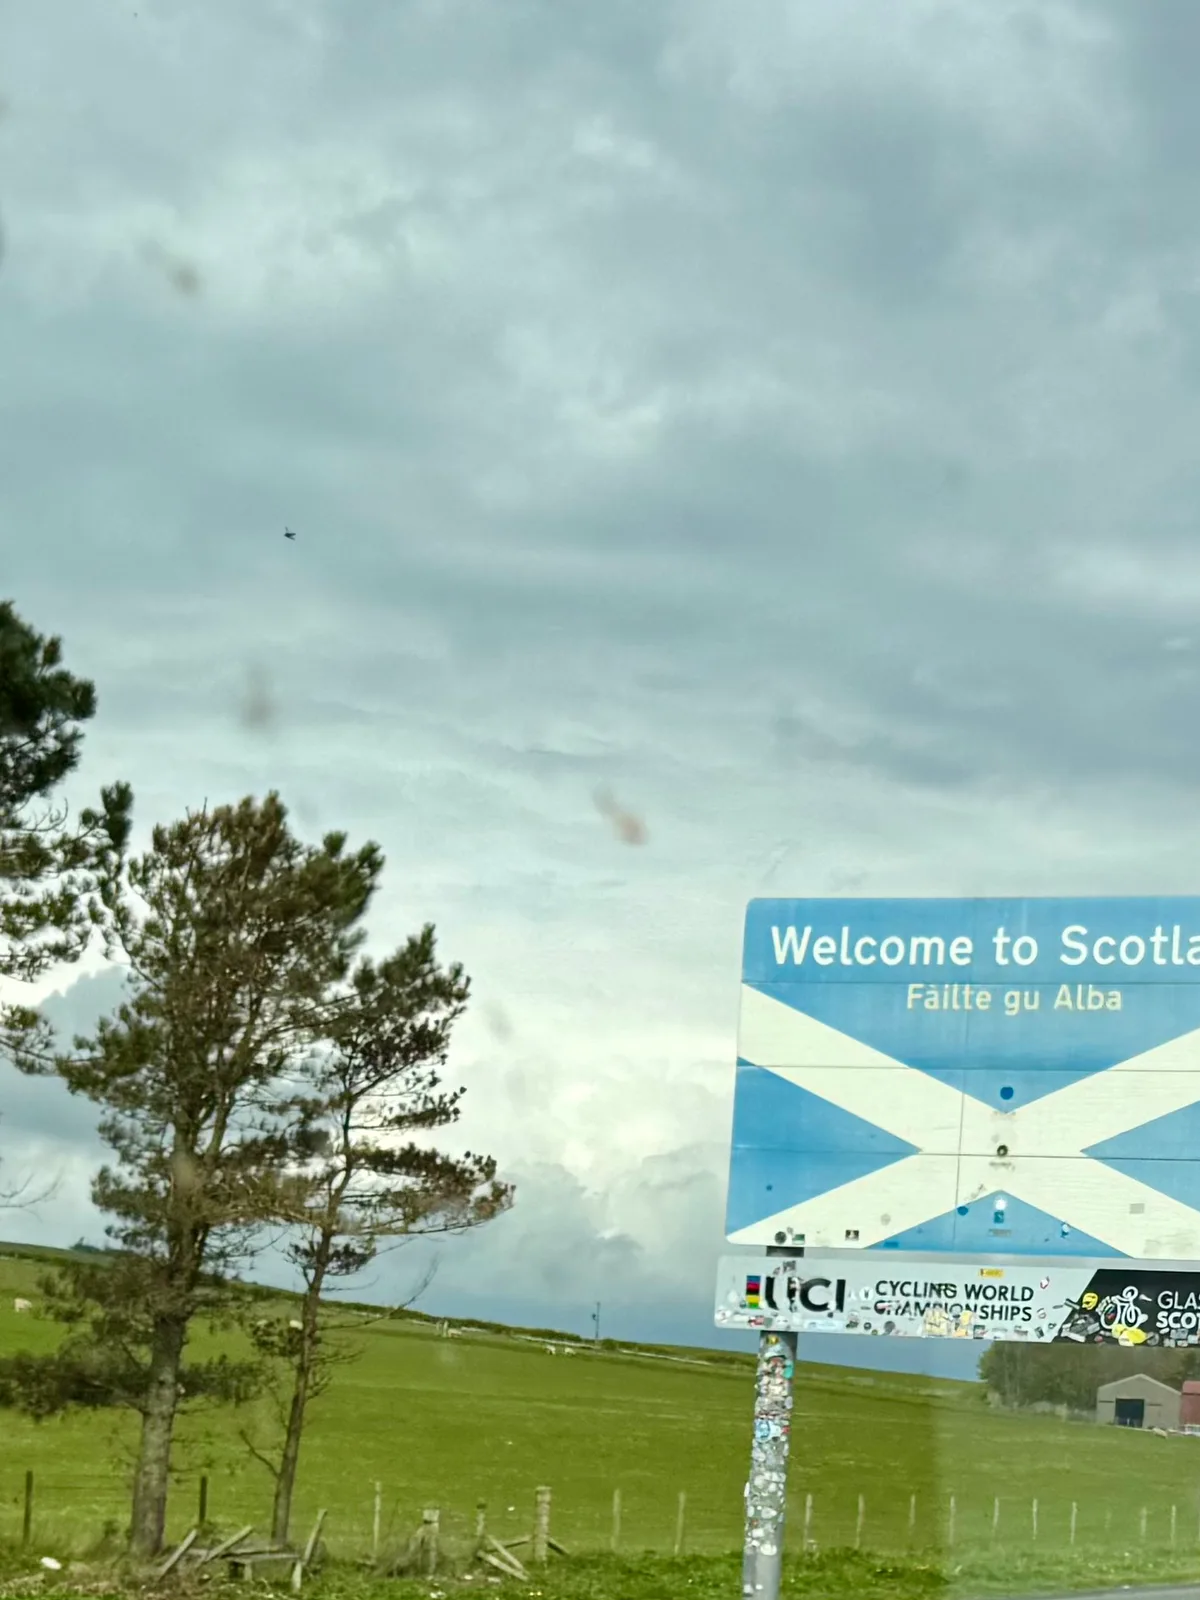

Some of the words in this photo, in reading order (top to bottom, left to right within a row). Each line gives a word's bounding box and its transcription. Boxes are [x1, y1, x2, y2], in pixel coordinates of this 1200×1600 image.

[771, 926, 973, 966] Welcome
[993, 927, 1038, 966] to
[907, 984, 991, 1010] Fàilte
[1004, 990, 1039, 1016] gu
[1054, 984, 1122, 1010] Alba
[875, 1280, 958, 1299] CYCLING
[964, 1284, 1034, 1302] WORLD
